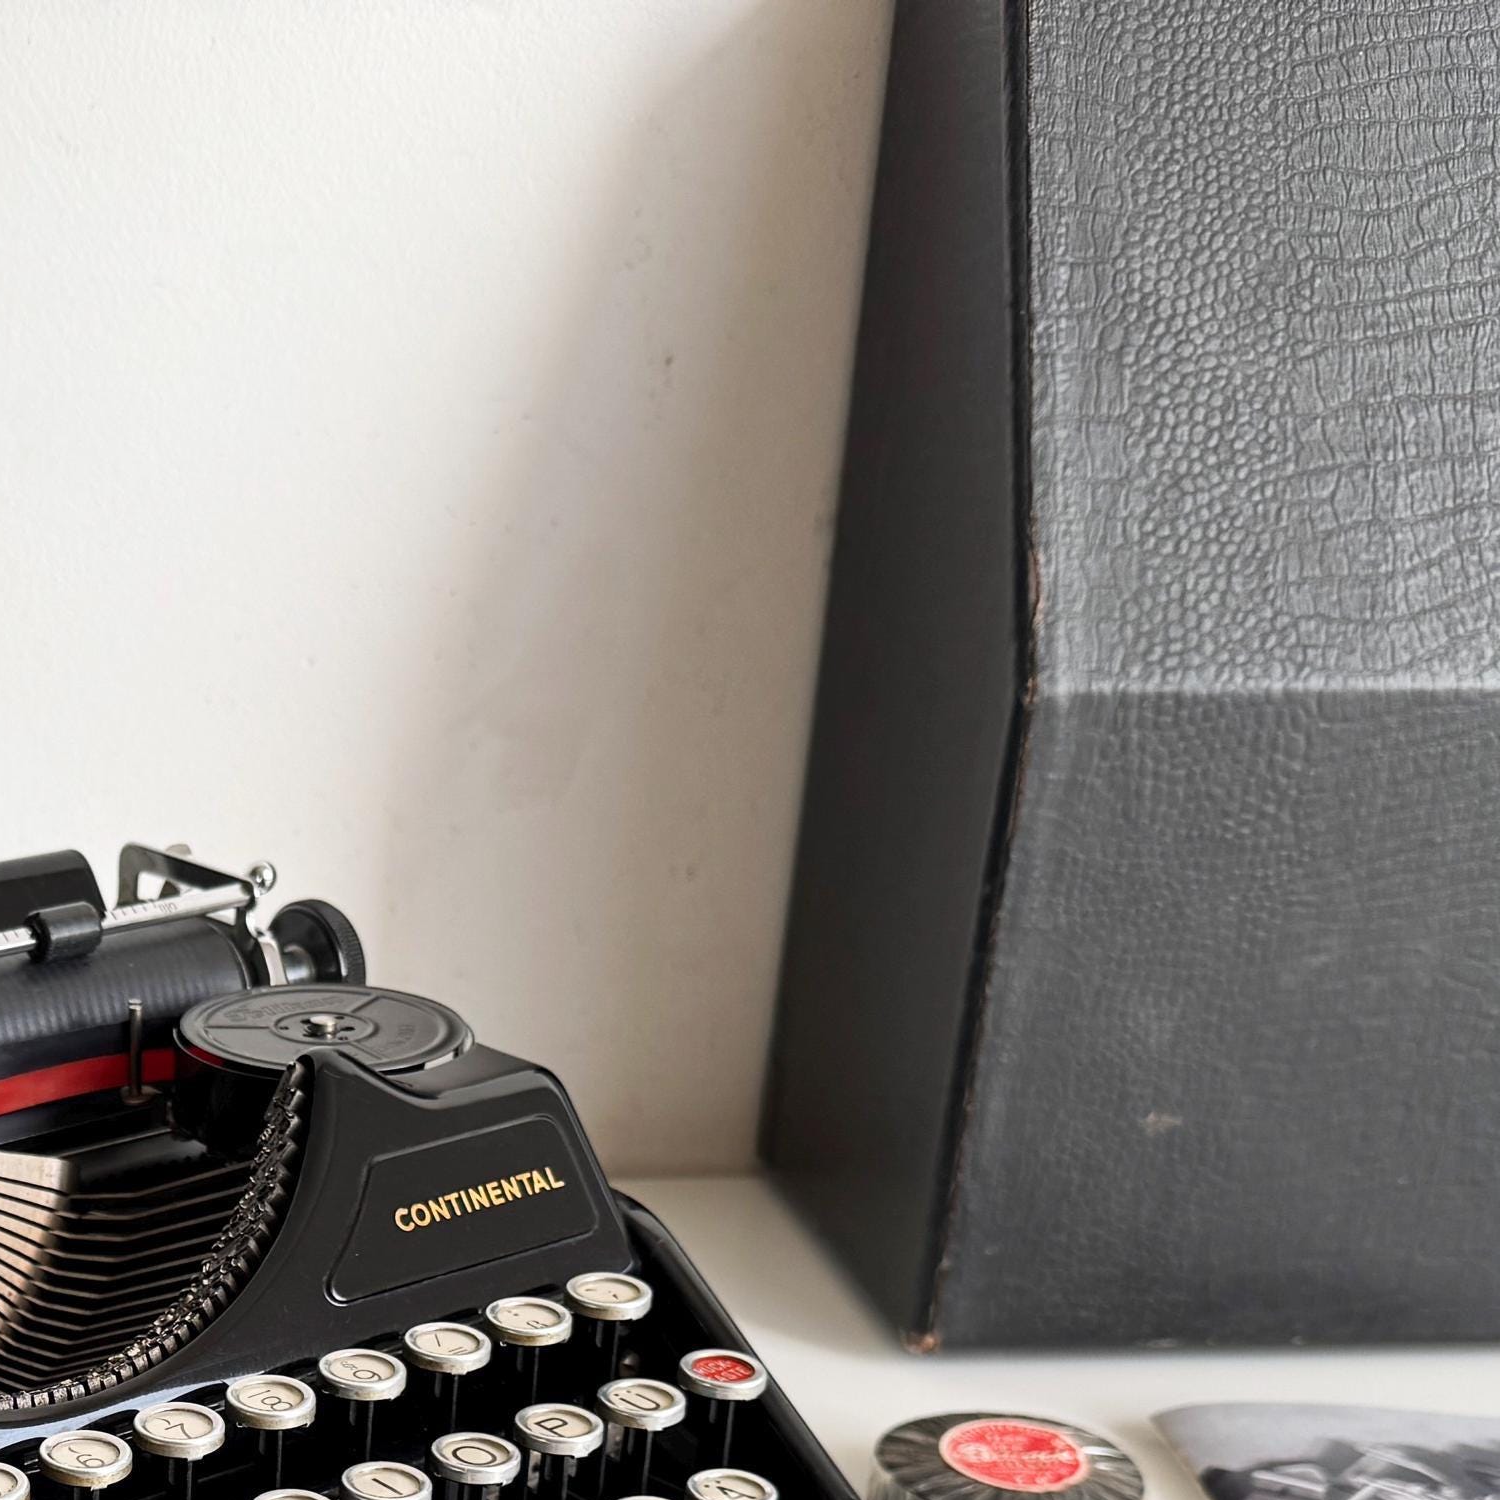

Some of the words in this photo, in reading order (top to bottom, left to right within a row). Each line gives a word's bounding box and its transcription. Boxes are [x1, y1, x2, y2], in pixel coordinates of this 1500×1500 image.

[394, 1166, 565, 1232] CONTINENTAL
[353, 1369, 383, 1381] 9
[260, 1395, 293, 1411] 8
[612, 1389, 661, 1411] Ü
[164, 1422, 192, 1440] 7
[533, 1417, 569, 1438] P
[76, 1453, 105, 1469] 6
[451, 1445, 498, 1466] O
[371, 1477, 404, 1496] I
